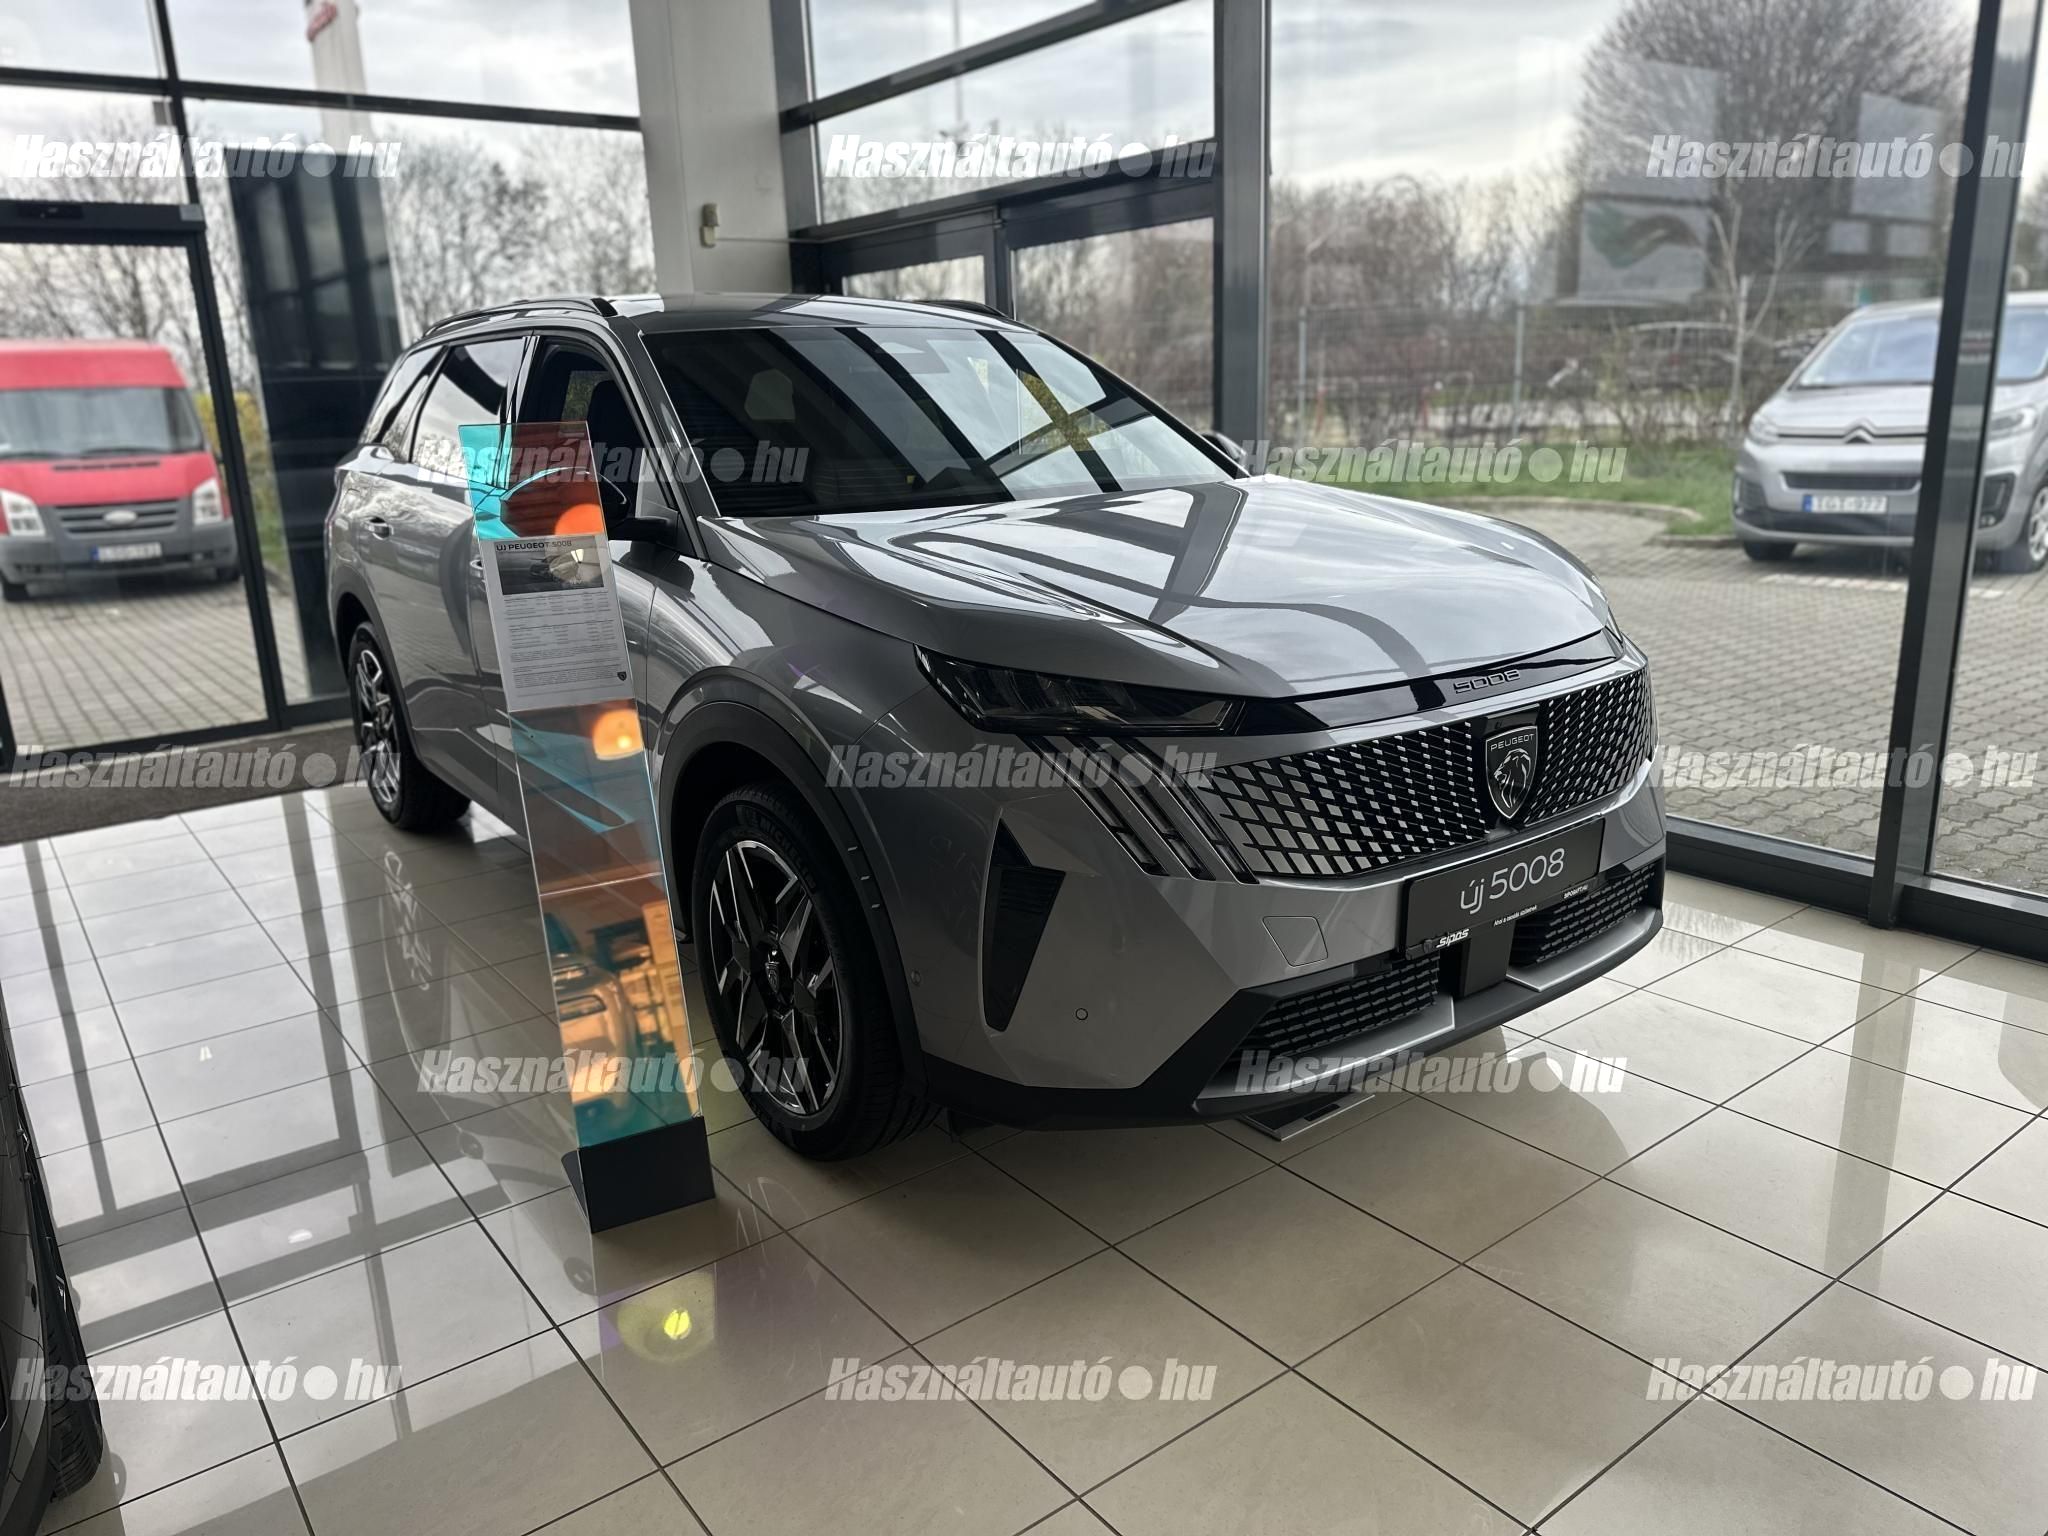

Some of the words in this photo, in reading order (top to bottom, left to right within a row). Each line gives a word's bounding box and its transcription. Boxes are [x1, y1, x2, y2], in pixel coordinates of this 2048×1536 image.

[508, 541, 549, 550] PEUGEOT
[1453, 669, 1521, 694] 5008
[1490, 733, 1535, 752] PEUGEOT
[1460, 878, 1485, 915] új
[1489, 848, 1565, 900] 5008
